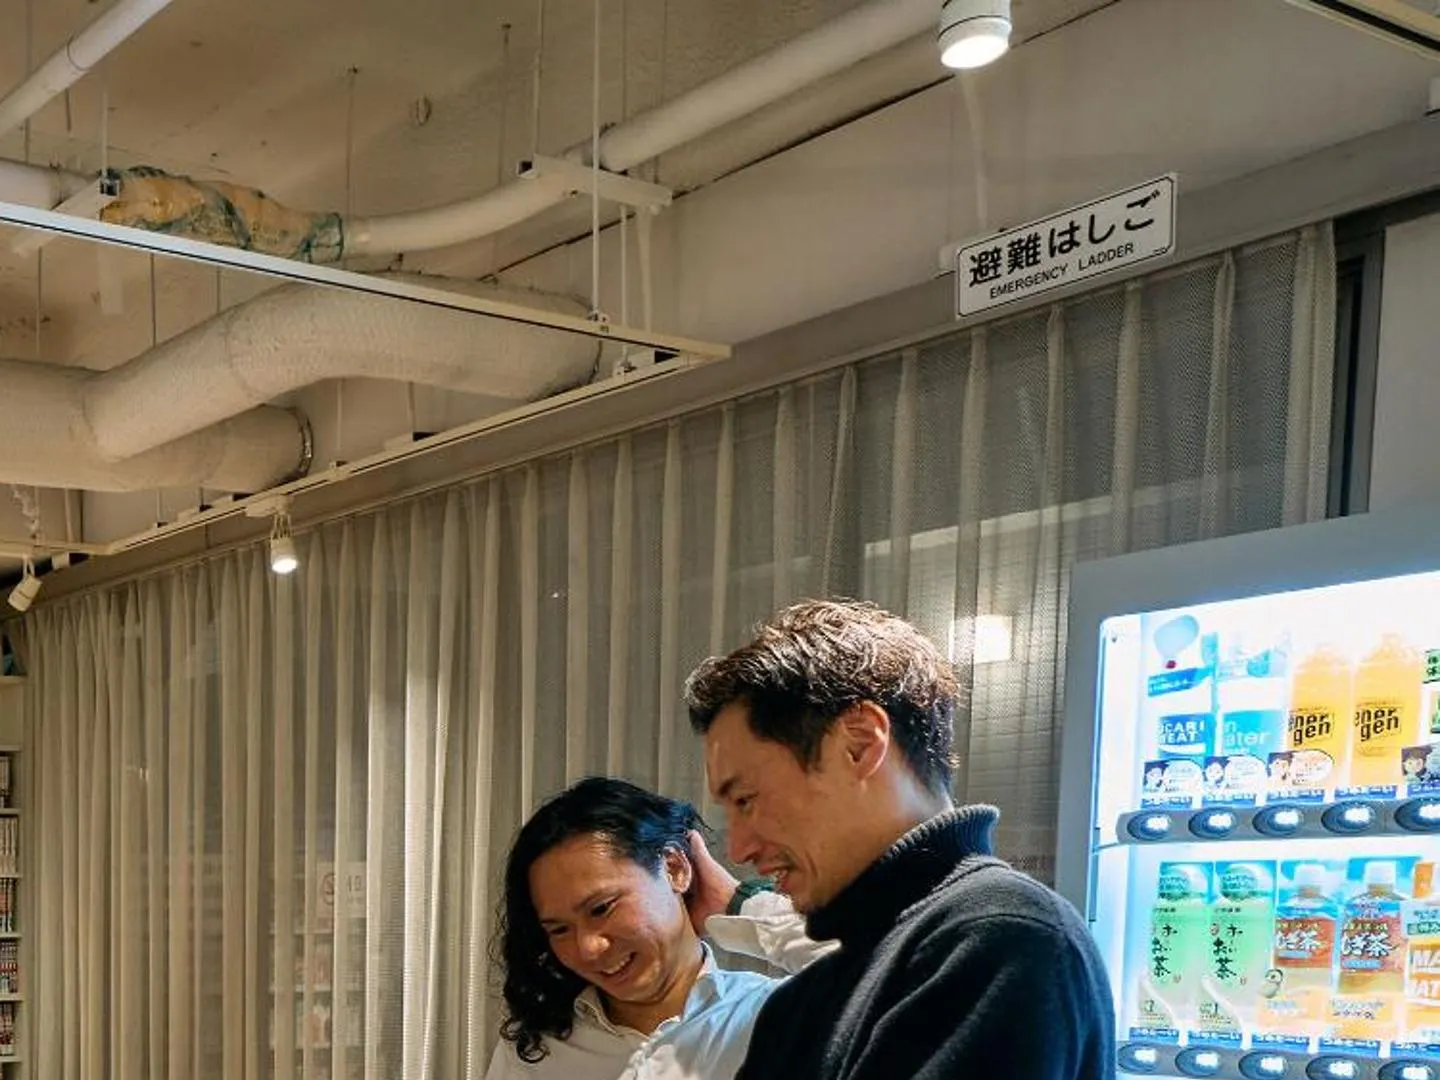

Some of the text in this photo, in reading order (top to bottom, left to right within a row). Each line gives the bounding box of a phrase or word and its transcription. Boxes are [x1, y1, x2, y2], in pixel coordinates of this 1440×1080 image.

[968, 188, 1160, 288] 避難はしご
[990, 242, 1134, 299] EMERGENCY LADDER
[1293, 720, 1332, 747] gen
[1360, 716, 1399, 742] gen
